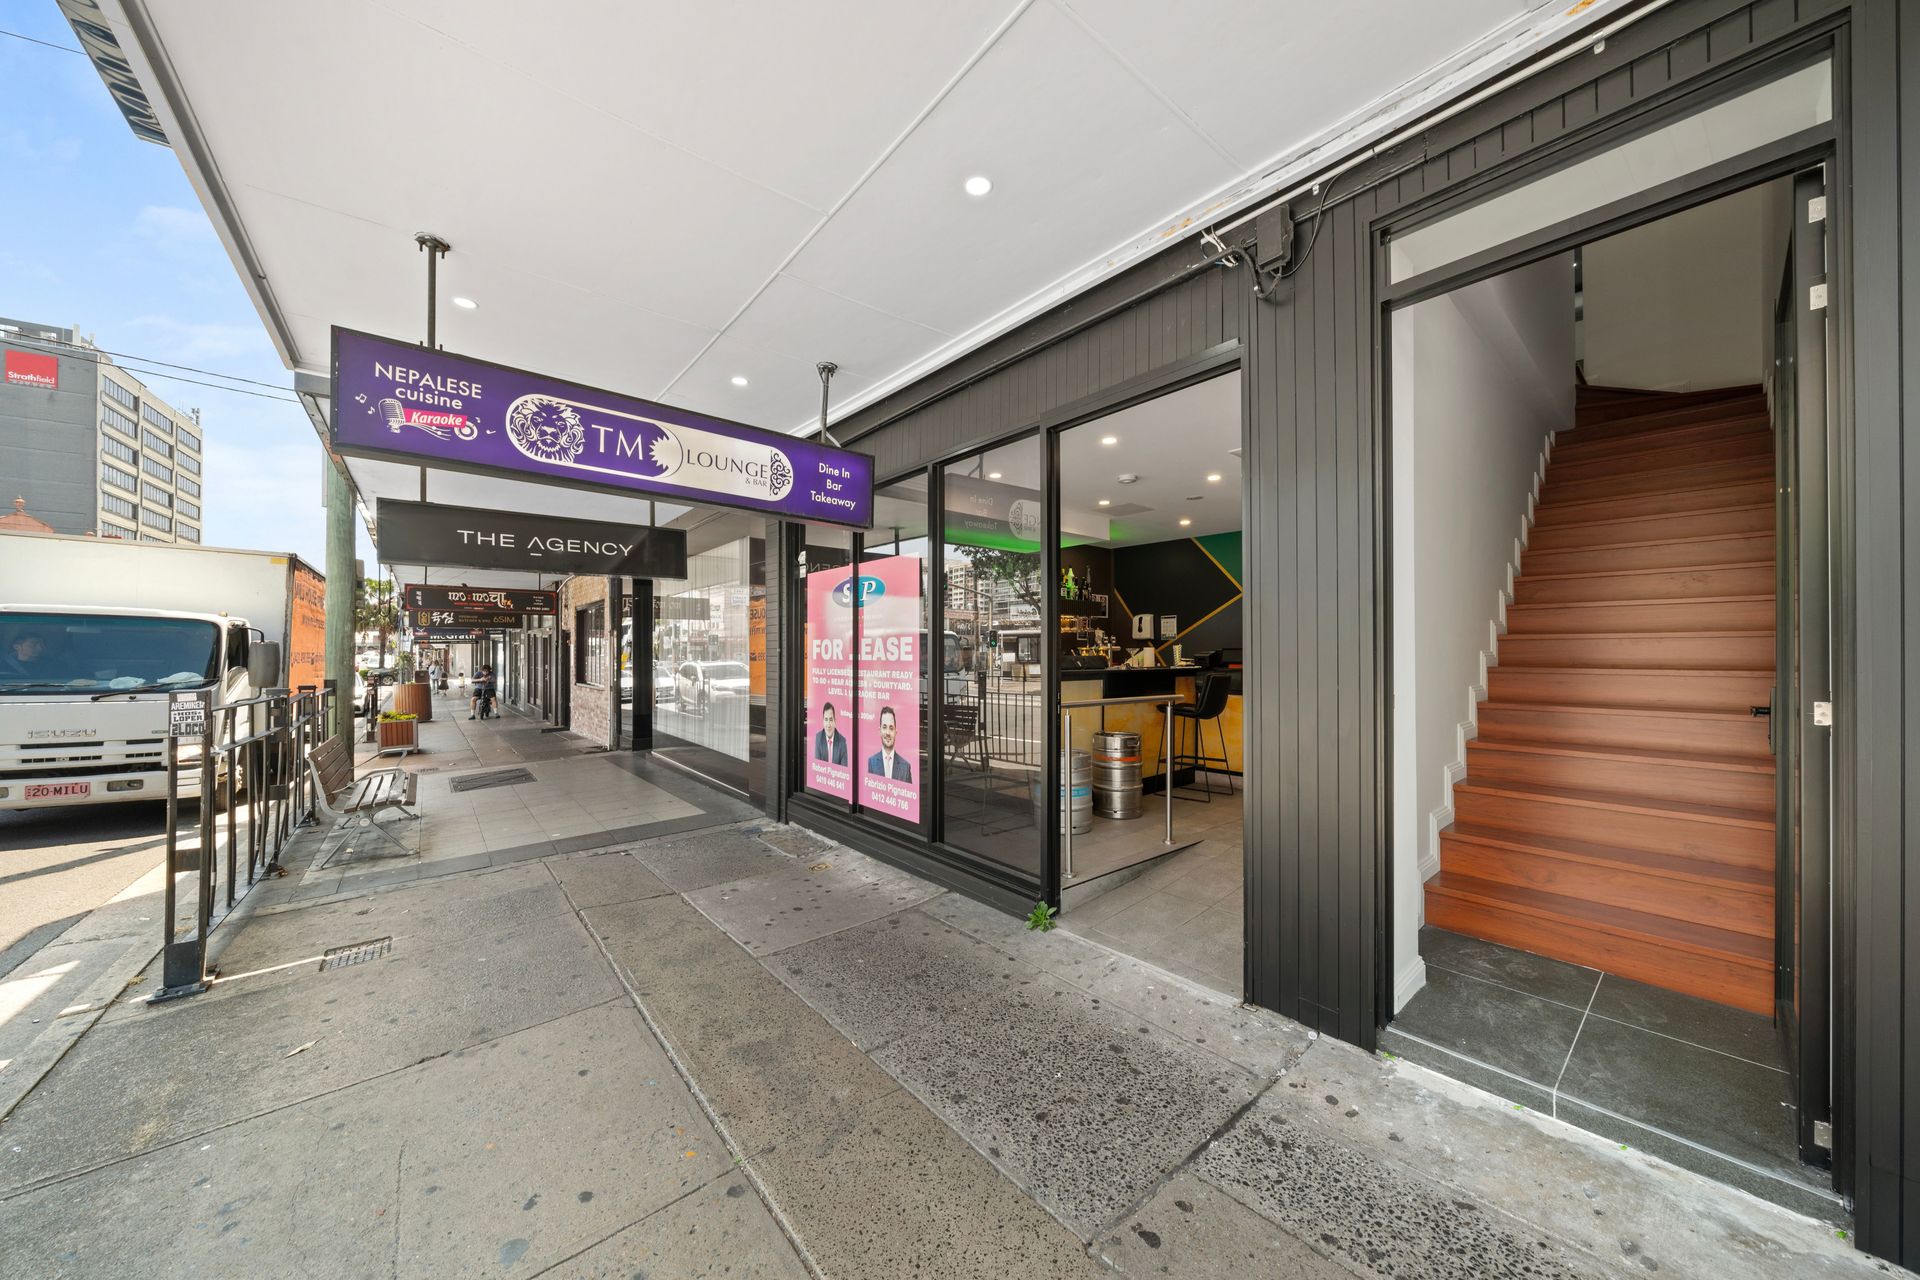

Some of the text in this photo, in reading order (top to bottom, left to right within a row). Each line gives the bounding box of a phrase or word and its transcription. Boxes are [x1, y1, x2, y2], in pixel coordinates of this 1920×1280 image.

[7, 371, 55, 384] Strathfield
[374, 361, 483, 400] NEPALESE
[394, 386, 464, 411] cuisine
[410, 411, 464, 428] Karaoke
[591, 424, 645, 461] TM
[685, 448, 769, 479] LOUNGE
[817, 462, 850, 479] Dine In
[752, 477, 768, 488] BAR
[826, 478, 843, 491] Bar
[810, 490, 857, 511] Takeaway
[456, 529, 516, 548] THE
[527, 536, 633, 557] AGENCY
[493, 615, 515, 624] 6SIM
[812, 636, 913, 662] FOR EASE
[858, 669, 890, 679] ESTAURANT
[891, 671, 913, 680] READY
[828, 687, 843, 696] LEVEL
[878, 691, 890, 700] BAR
[27, 728, 97, 739] ISUZU
[31, 785, 89, 797] 20-MILU
[864, 777, 918, 800] Fabrizio Pignataro
[871, 791, 885, 803] 0412
